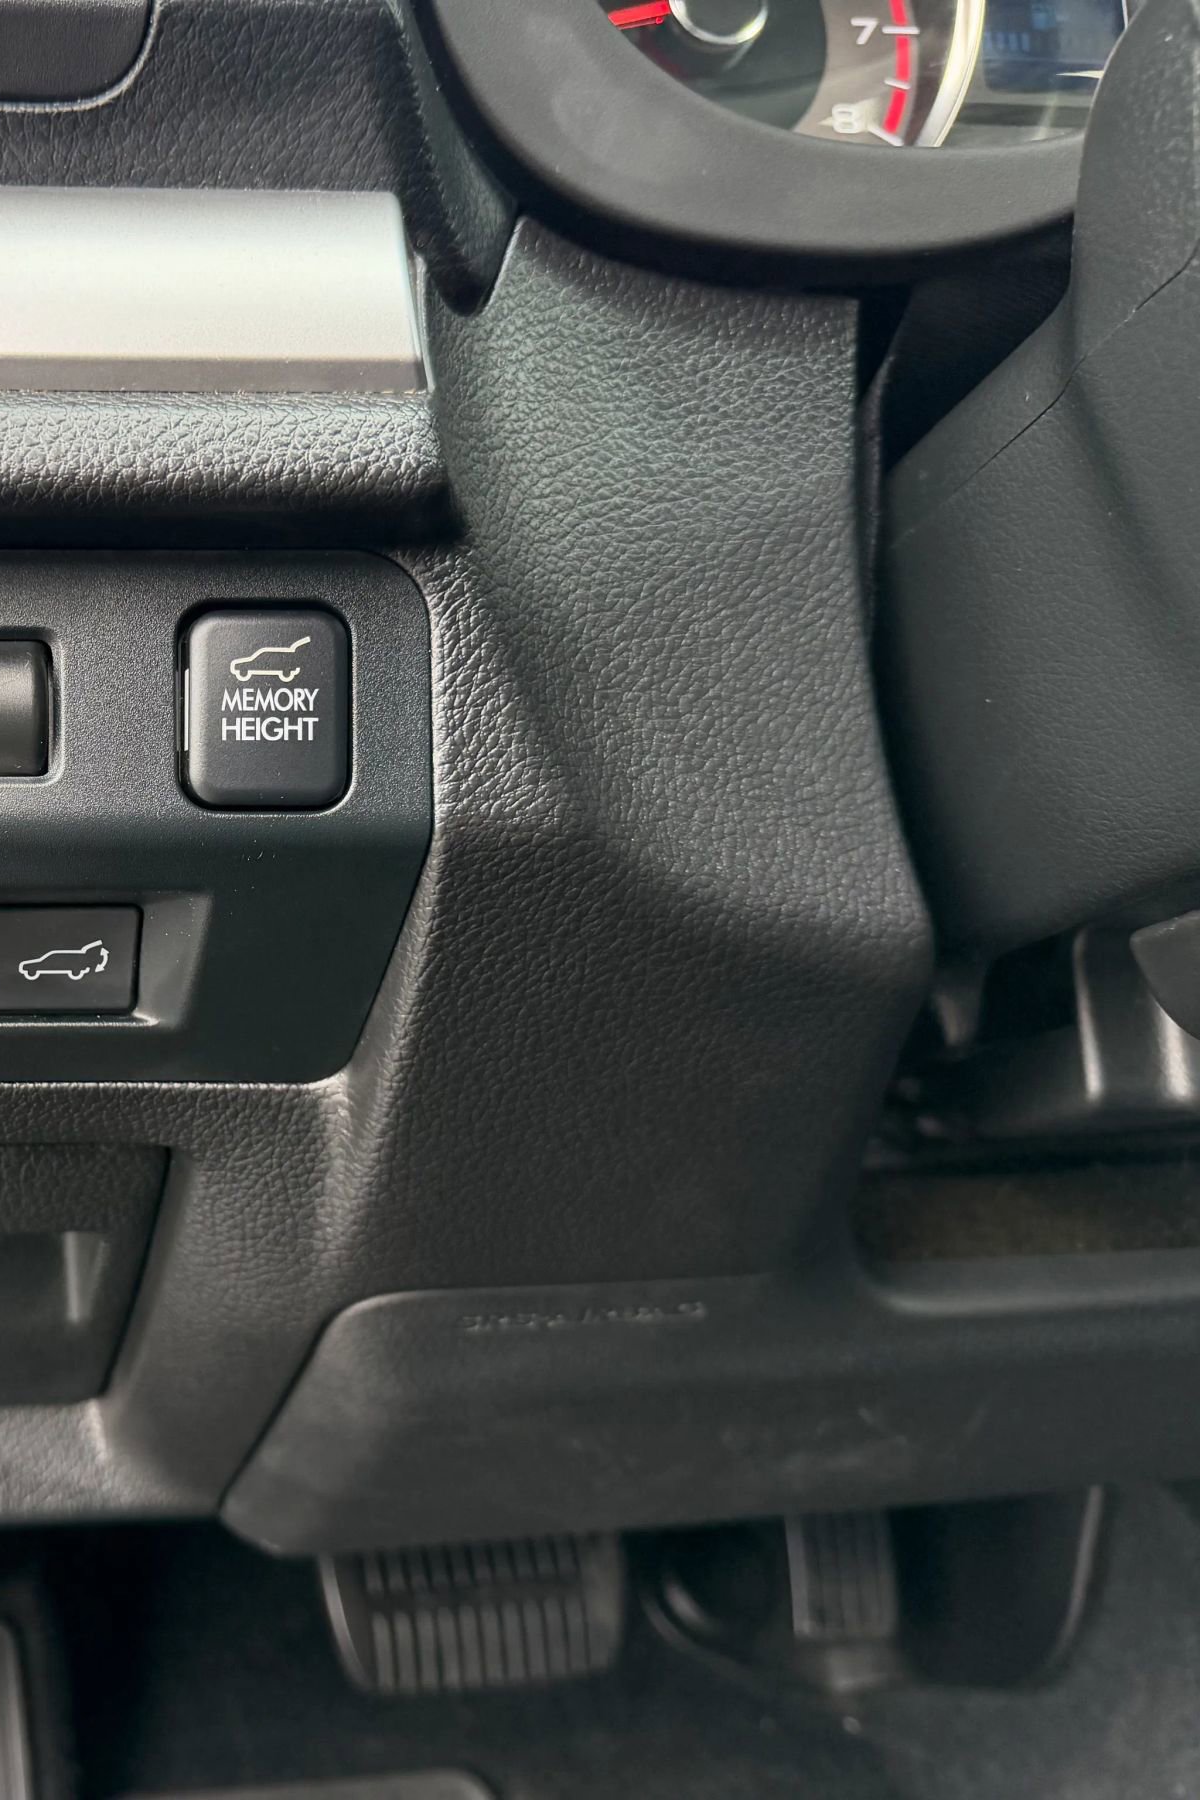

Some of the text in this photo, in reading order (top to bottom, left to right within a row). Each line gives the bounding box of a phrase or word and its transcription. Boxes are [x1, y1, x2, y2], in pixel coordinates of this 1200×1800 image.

[850, 17, 879, 45] 7
[831, 103, 861, 134] 8
[221, 687, 319, 711] MEMORY
[221, 717, 319, 741] HEIGHT
